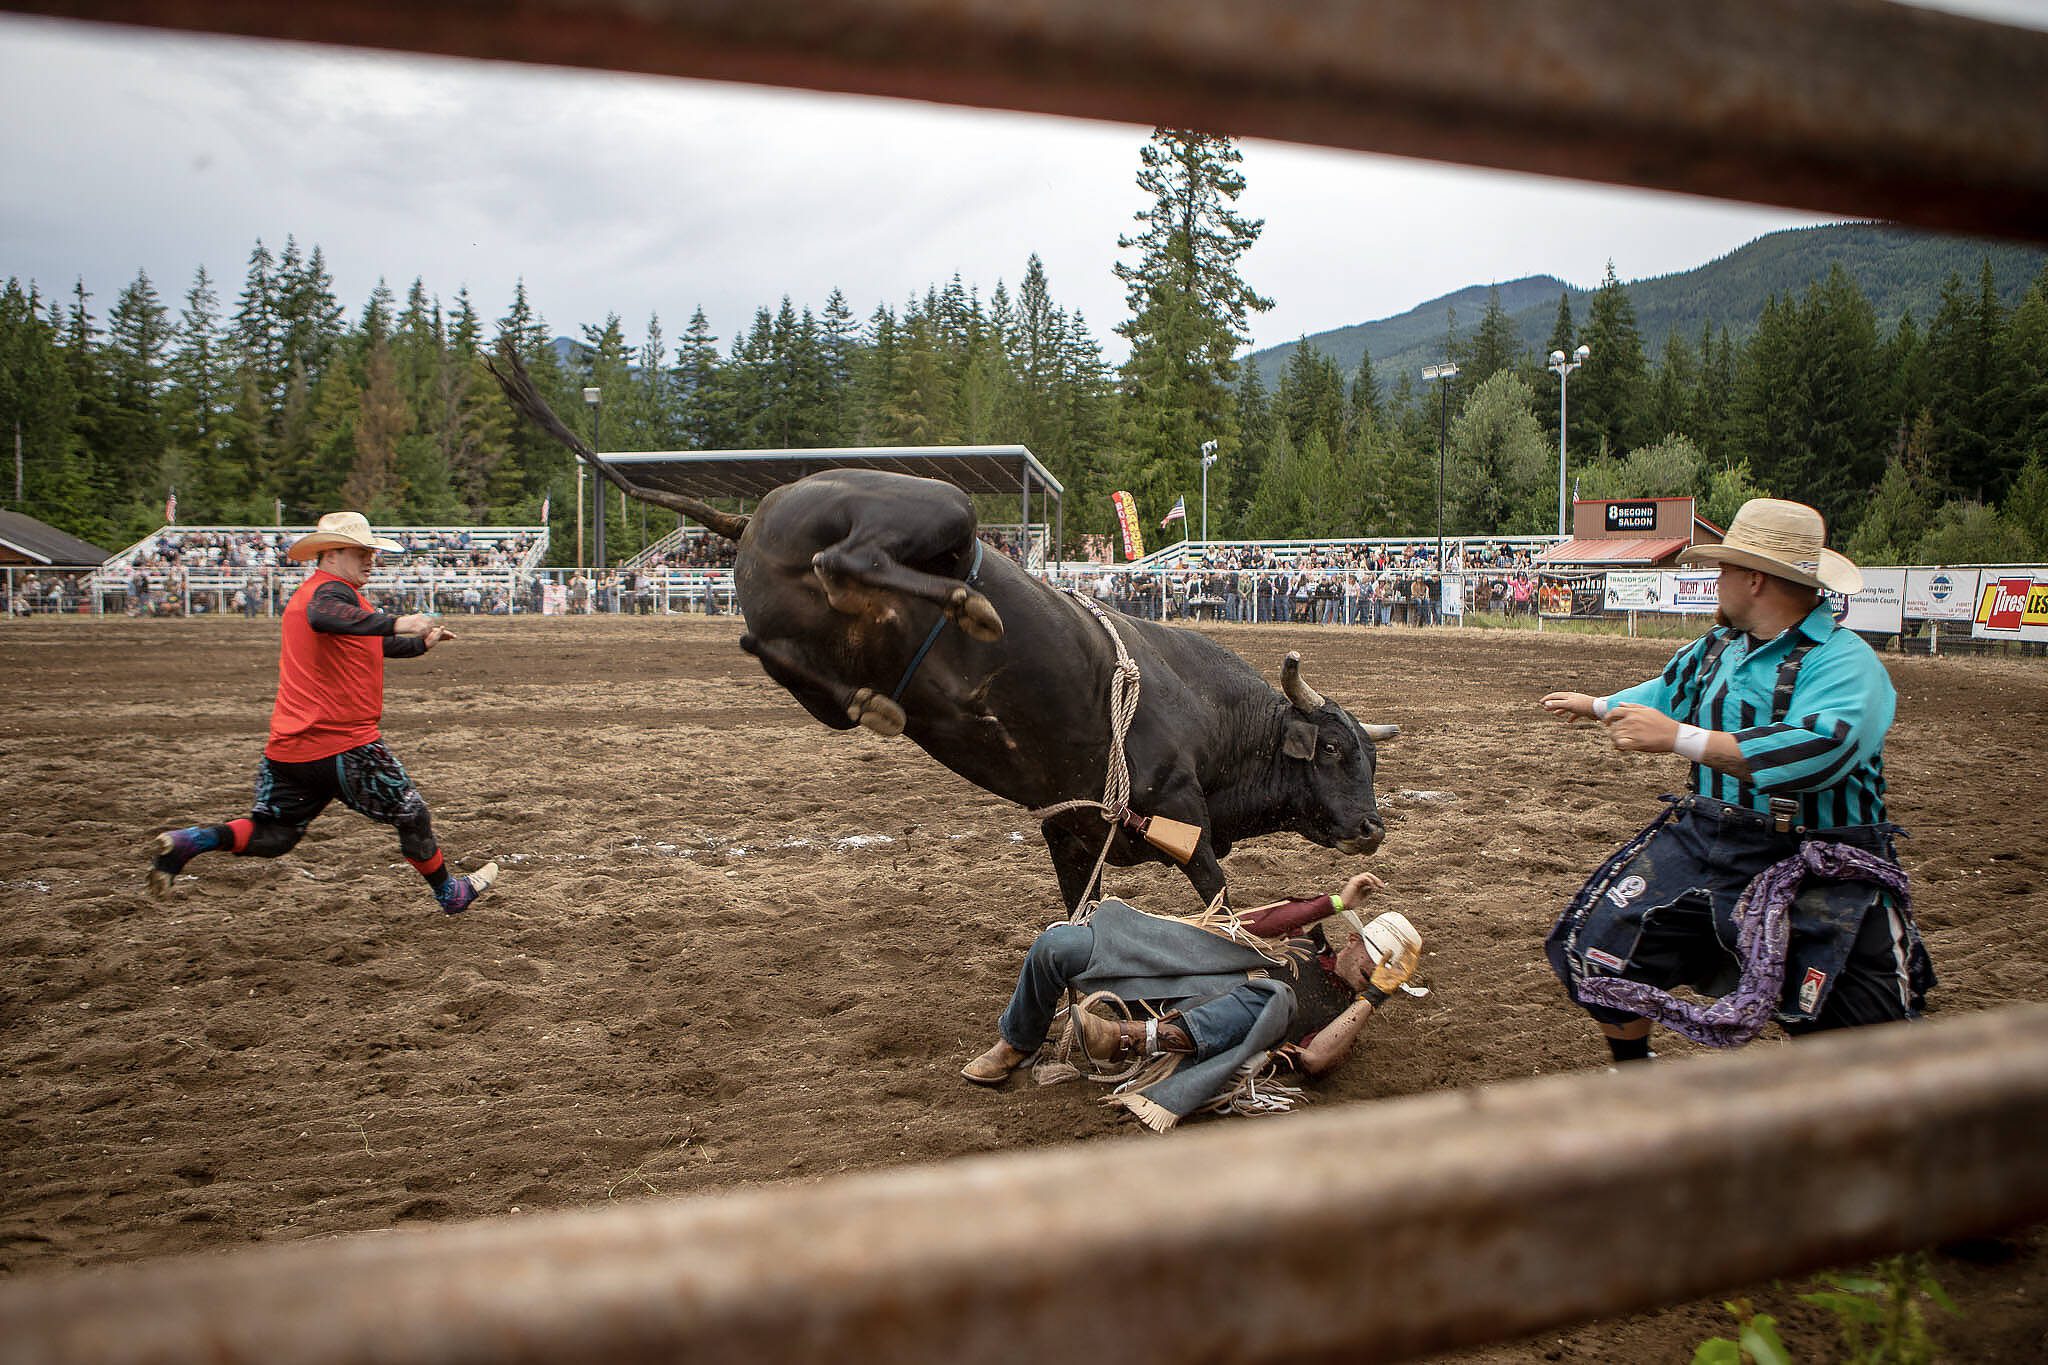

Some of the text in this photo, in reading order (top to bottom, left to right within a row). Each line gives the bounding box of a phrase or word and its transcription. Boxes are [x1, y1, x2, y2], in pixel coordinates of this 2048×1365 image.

[1609, 505, 1653, 520] 8 SECOND
[1618, 517, 1653, 528] SALOON
[1879, 596, 1900, 606] County
[1993, 586, 2048, 616] Tires LES
